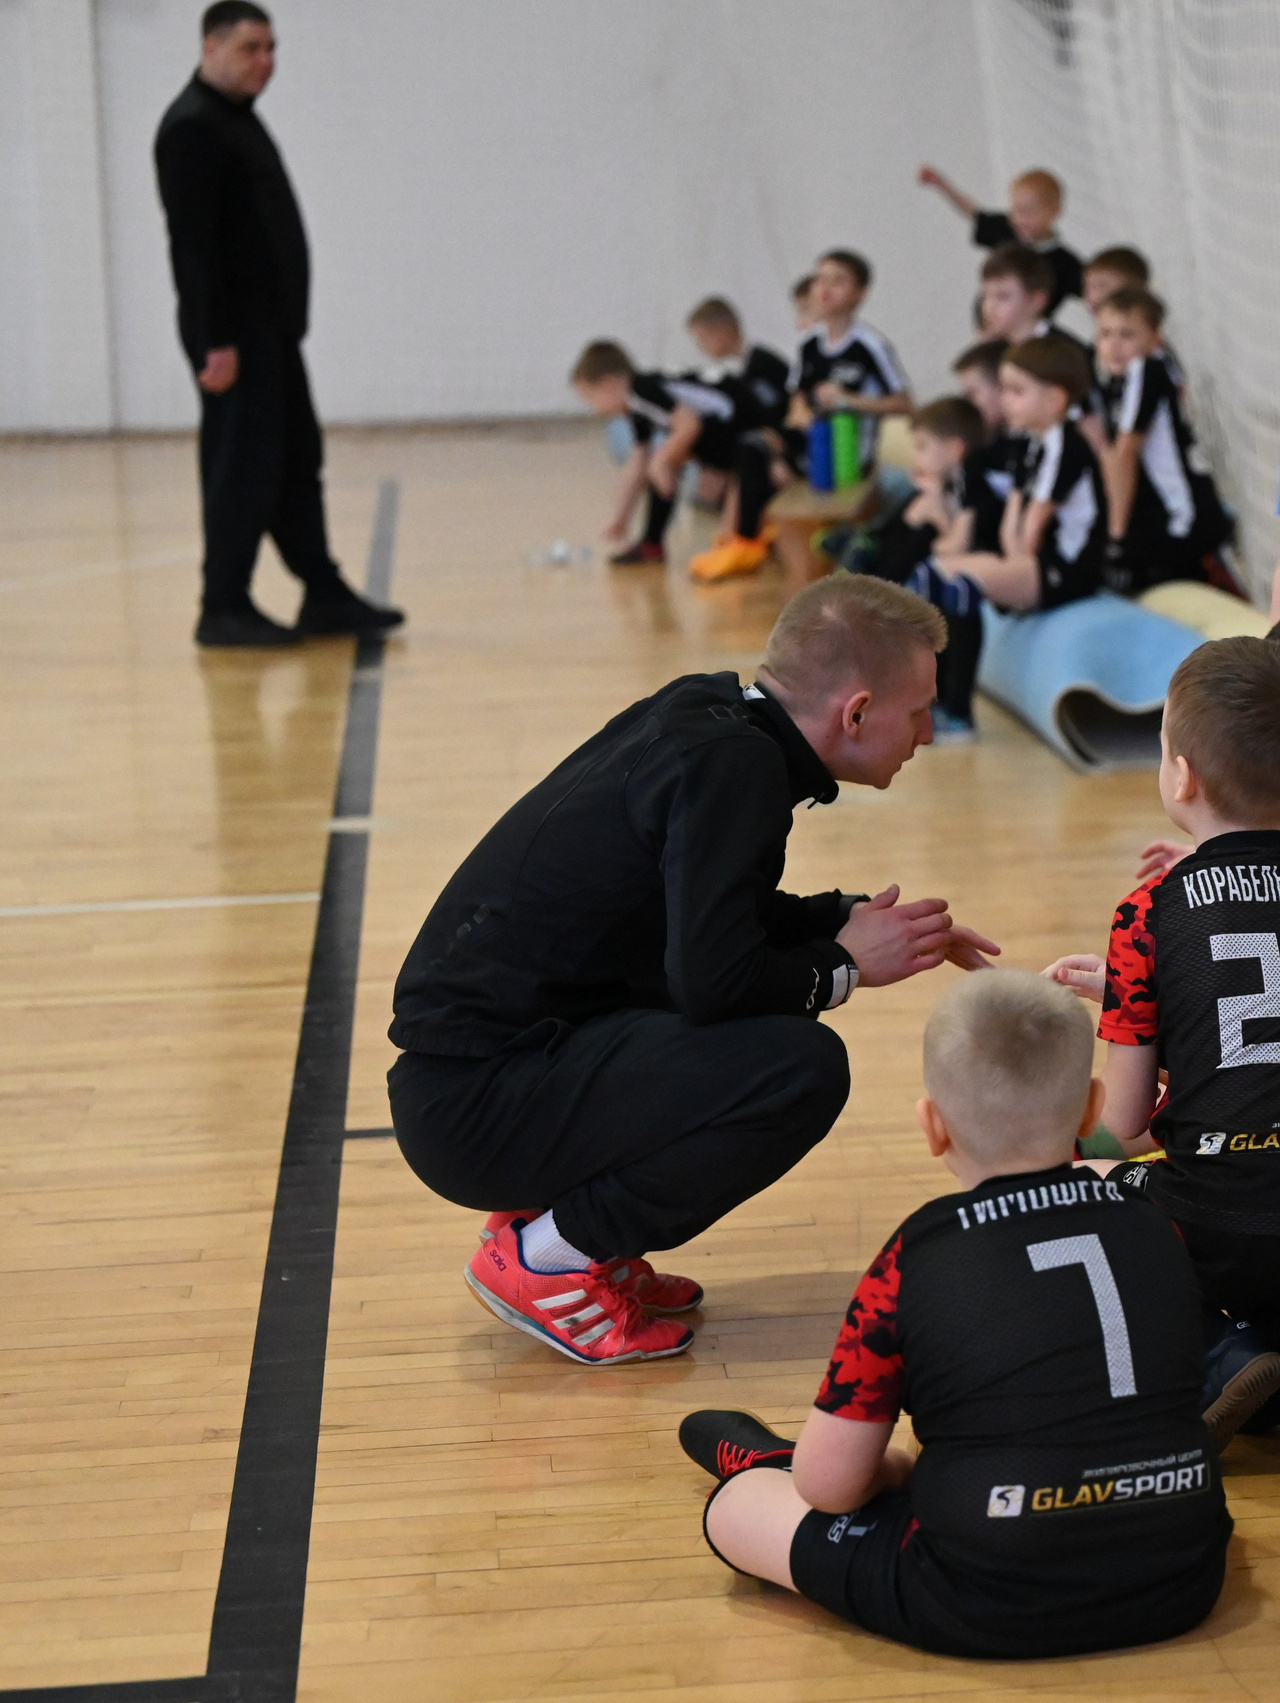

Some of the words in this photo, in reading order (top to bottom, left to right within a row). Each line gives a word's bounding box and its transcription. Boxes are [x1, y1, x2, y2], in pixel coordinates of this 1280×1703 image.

[489, 1249, 507, 1271] sala
[1026, 1233, 1138, 1398] 7
[1031, 1463, 1206, 1512] GLAVSPORT
